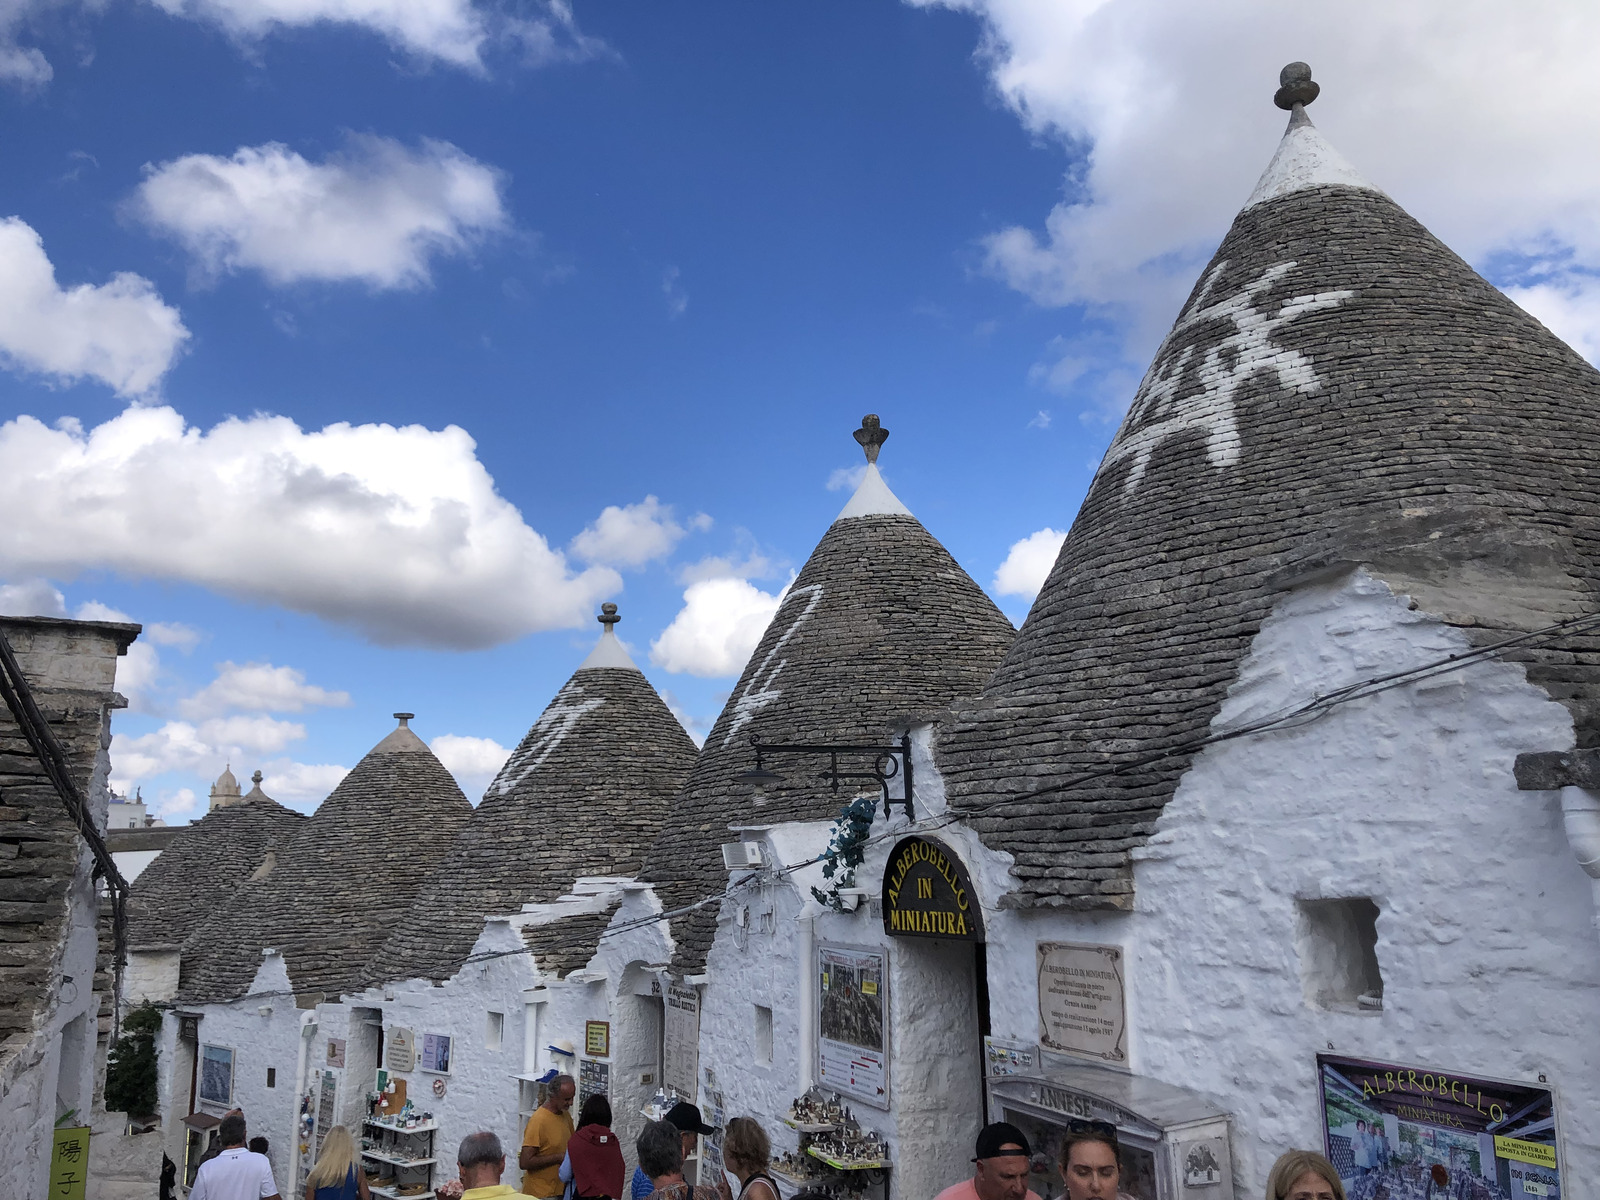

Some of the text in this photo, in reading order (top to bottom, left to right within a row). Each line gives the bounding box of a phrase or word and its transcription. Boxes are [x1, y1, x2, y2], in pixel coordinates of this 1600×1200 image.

[888, 841, 969, 911] ALBEROBELLO
[917, 878, 932, 899] IN
[891, 909, 967, 935] MINIATURA
[1043, 964, 1078, 977] ALBEROBELLO
[1086, 969, 1116, 981] MINIATURA
[651, 981, 660, 993] 32
[1039, 1086, 1093, 1118] ANNESE
[1362, 1069, 1504, 1123] ALBEROBELLO
[1422, 1095, 1434, 1107] IN
[1397, 1104, 1465, 1129] MINIATURA
[1496, 1146, 1520, 1155] ESPOSTA
[1527, 1151, 1556, 1163] GIARDINO
[1511, 1143, 1542, 1154] MINIATURA
[1511, 1169, 1559, 1187] IN SCALA
